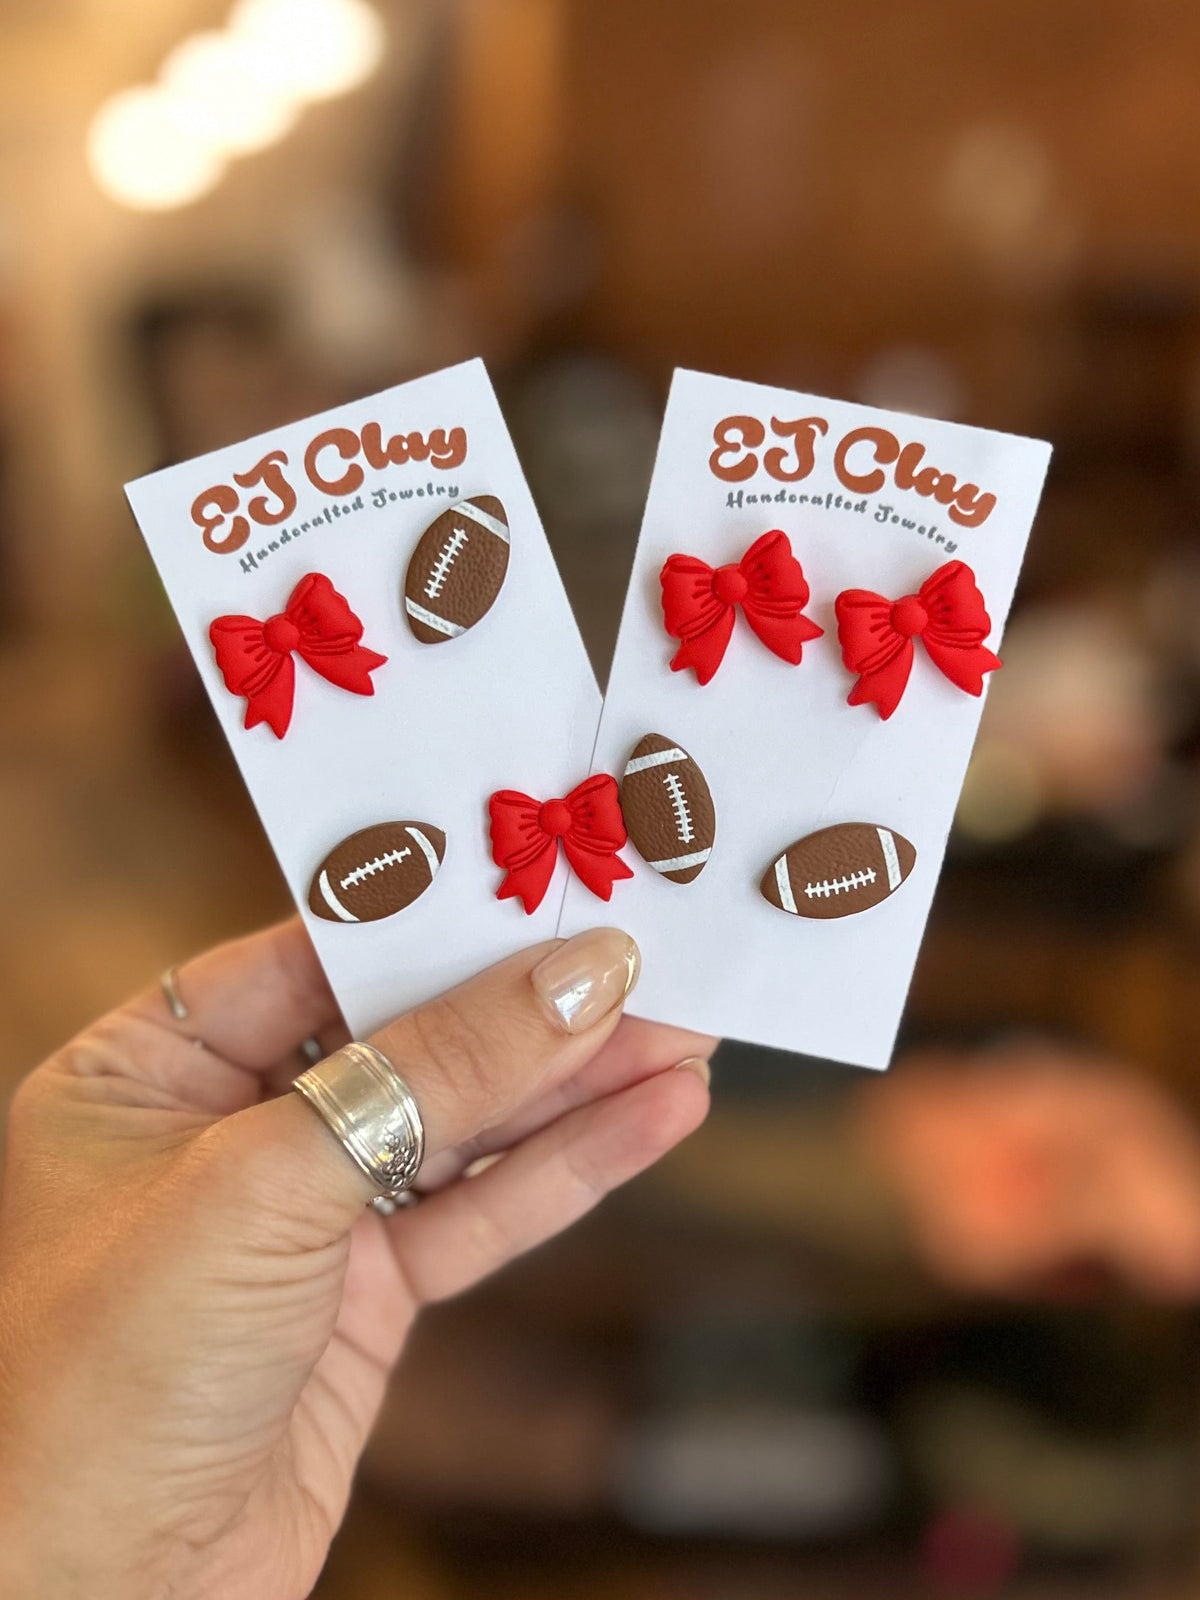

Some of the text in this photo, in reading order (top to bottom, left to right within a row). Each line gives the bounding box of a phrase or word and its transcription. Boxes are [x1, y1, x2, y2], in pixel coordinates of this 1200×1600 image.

[191, 421, 468, 554] EJ Clay
[709, 415, 998, 528] EJ Clay
[726, 488, 959, 553] Handcrafted Jewelry
[239, 482, 460, 574] Handcrafted Jewelry
